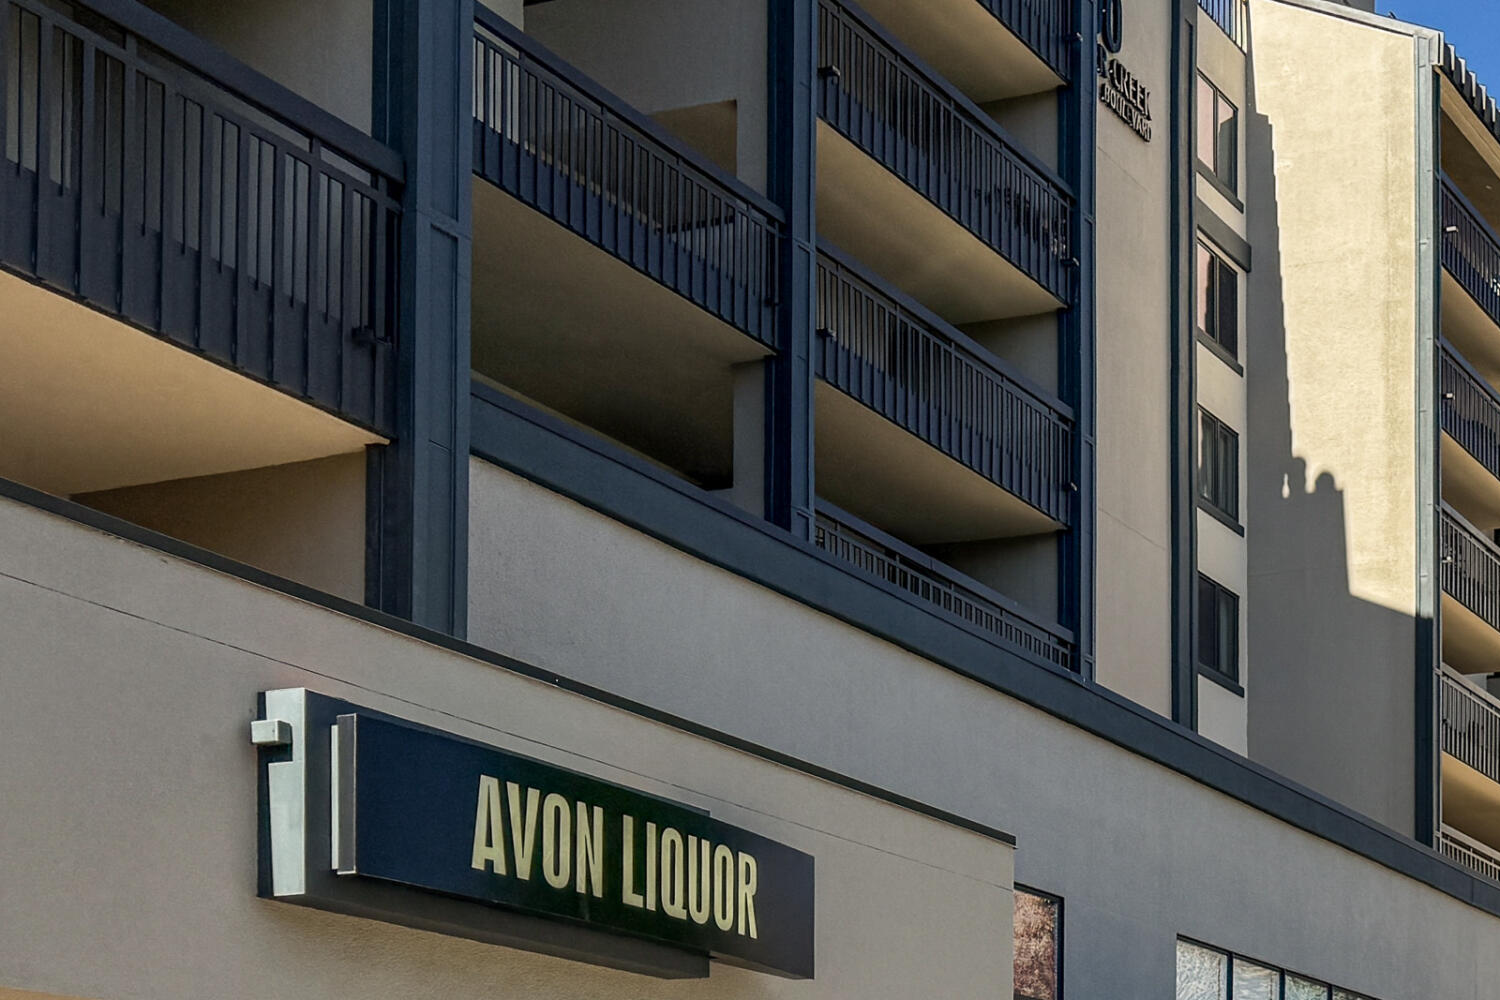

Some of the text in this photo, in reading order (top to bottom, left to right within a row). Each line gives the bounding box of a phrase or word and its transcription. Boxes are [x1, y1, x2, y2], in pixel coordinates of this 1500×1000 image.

[1099, 82, 1152, 143] BOULEVARD
[1108, 58, 1152, 121] CREEK
[471, 774, 758, 939] AVON LIQUOR
